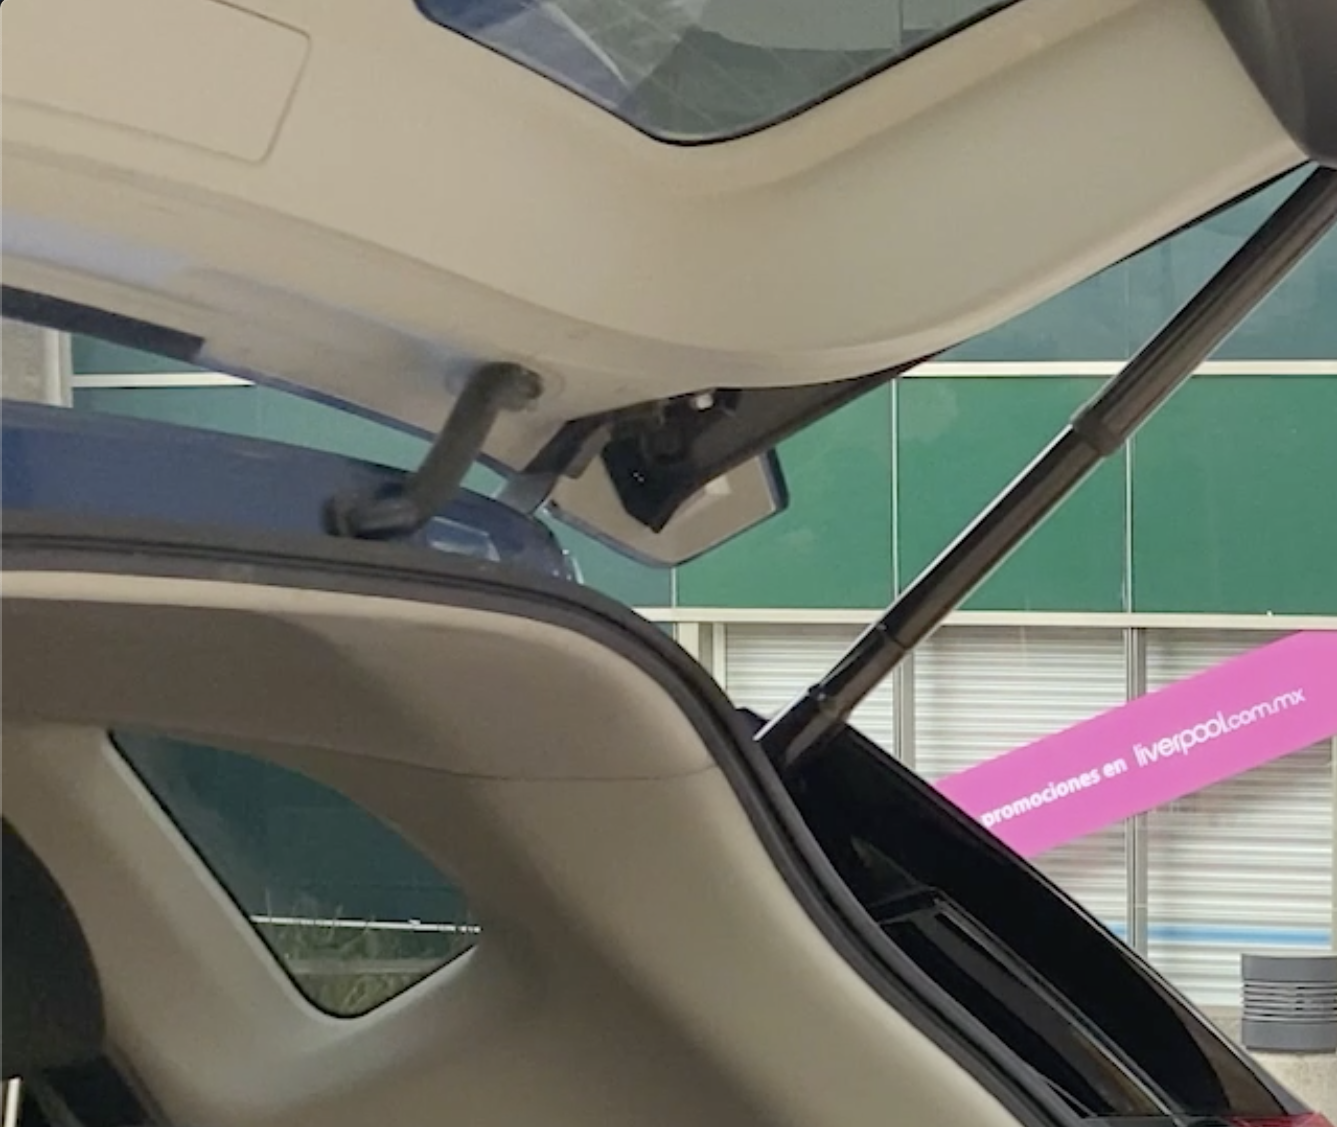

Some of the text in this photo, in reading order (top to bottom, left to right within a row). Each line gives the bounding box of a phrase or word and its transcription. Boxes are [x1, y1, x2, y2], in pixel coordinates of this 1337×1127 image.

[980, 688, 1306, 829] promociones en liverpool.com.mx
